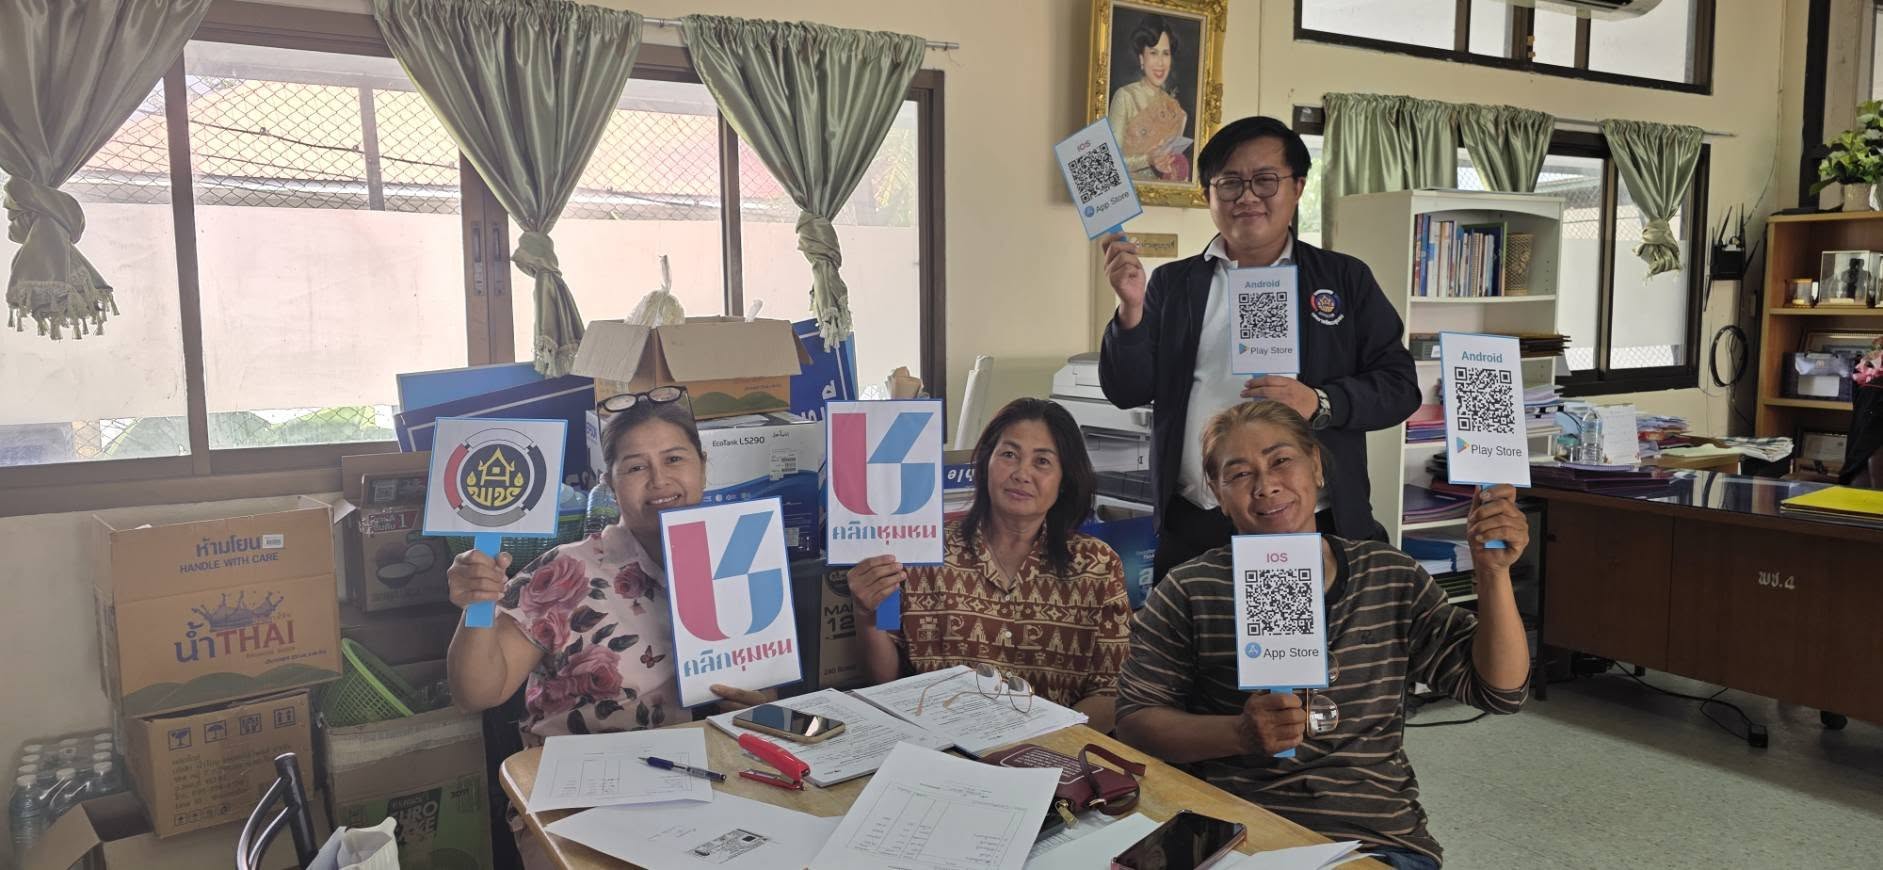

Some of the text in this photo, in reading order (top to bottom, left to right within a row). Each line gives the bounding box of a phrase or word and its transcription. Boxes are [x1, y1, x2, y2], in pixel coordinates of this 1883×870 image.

[1096, 191, 1129, 214] App Store
[1244, 279, 1280, 289] Android
[1250, 345, 1293, 356] Play Store
[1461, 350, 1503, 364] Android
[712, 436, 766, 448] EcoTank L5290
[1471, 443, 1523, 458] Play Store
[832, 520, 937, 546] คลิกชุมชน
[195, 535, 262, 558] ห้ามโยน
[180, 551, 279, 573] HANDLE WITH CARE
[1266, 552, 1288, 563] IOS
[683, 638, 793, 678] คลิกชุมชน
[1263, 647, 1319, 661] App Store
